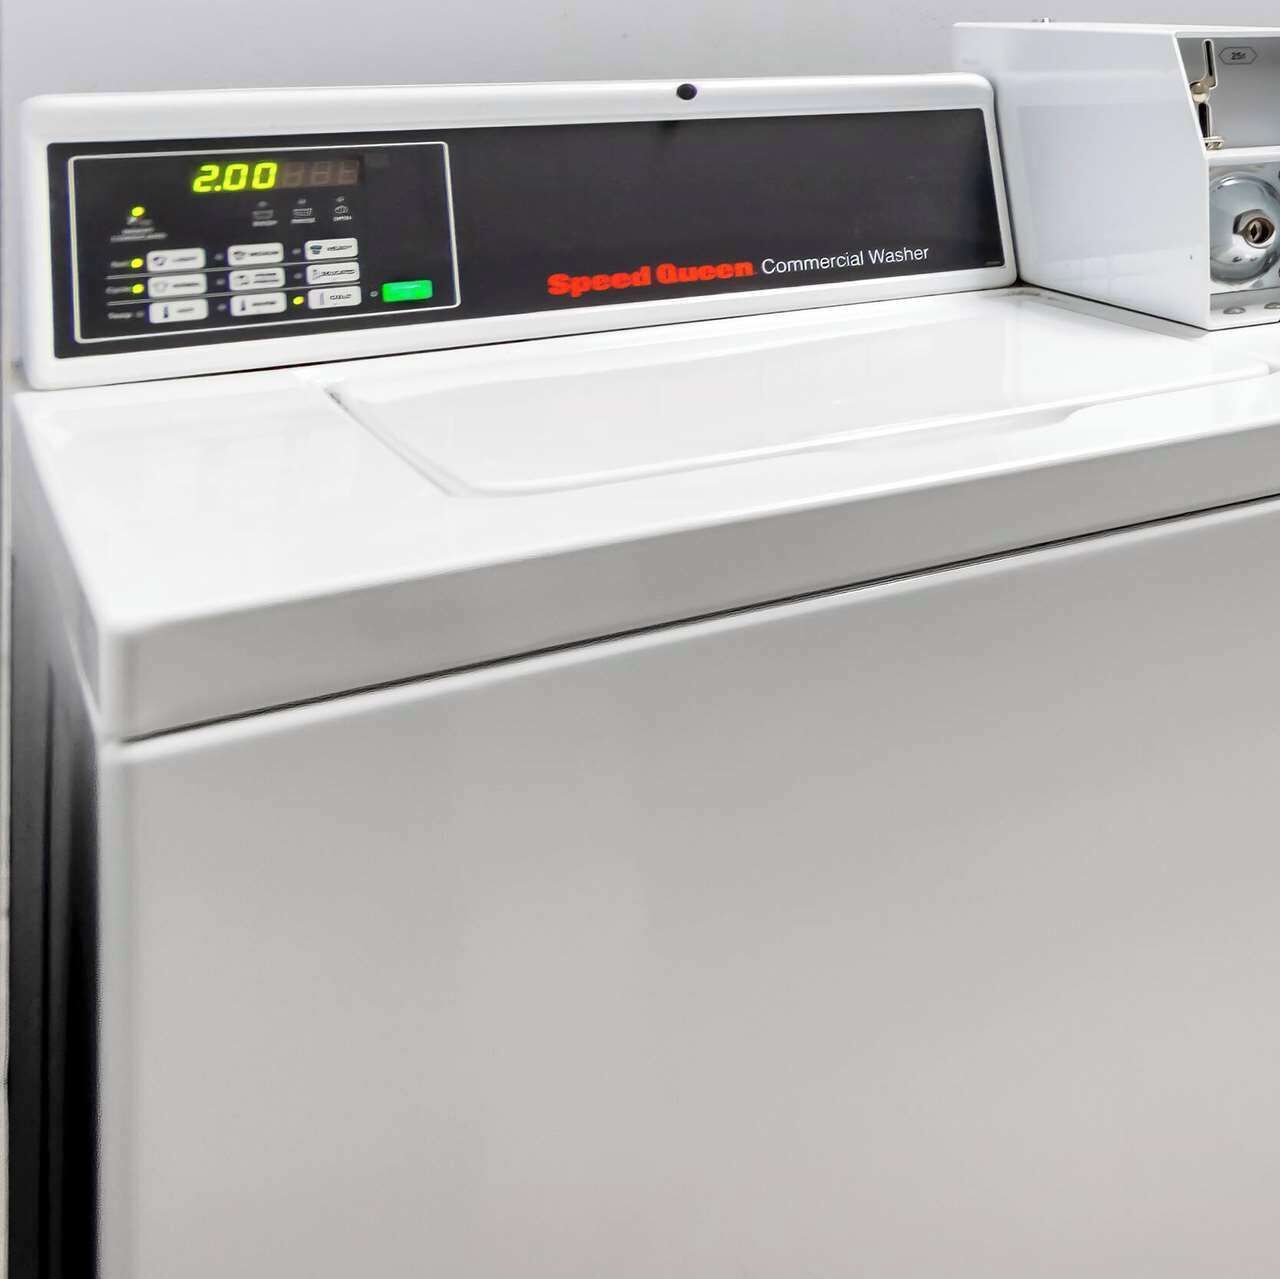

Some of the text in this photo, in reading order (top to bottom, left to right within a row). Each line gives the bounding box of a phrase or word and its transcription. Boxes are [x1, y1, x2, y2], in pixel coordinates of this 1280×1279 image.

[193, 162, 278, 193] 2.00
[547, 246, 929, 298] Speed Queen Commercial Washer
